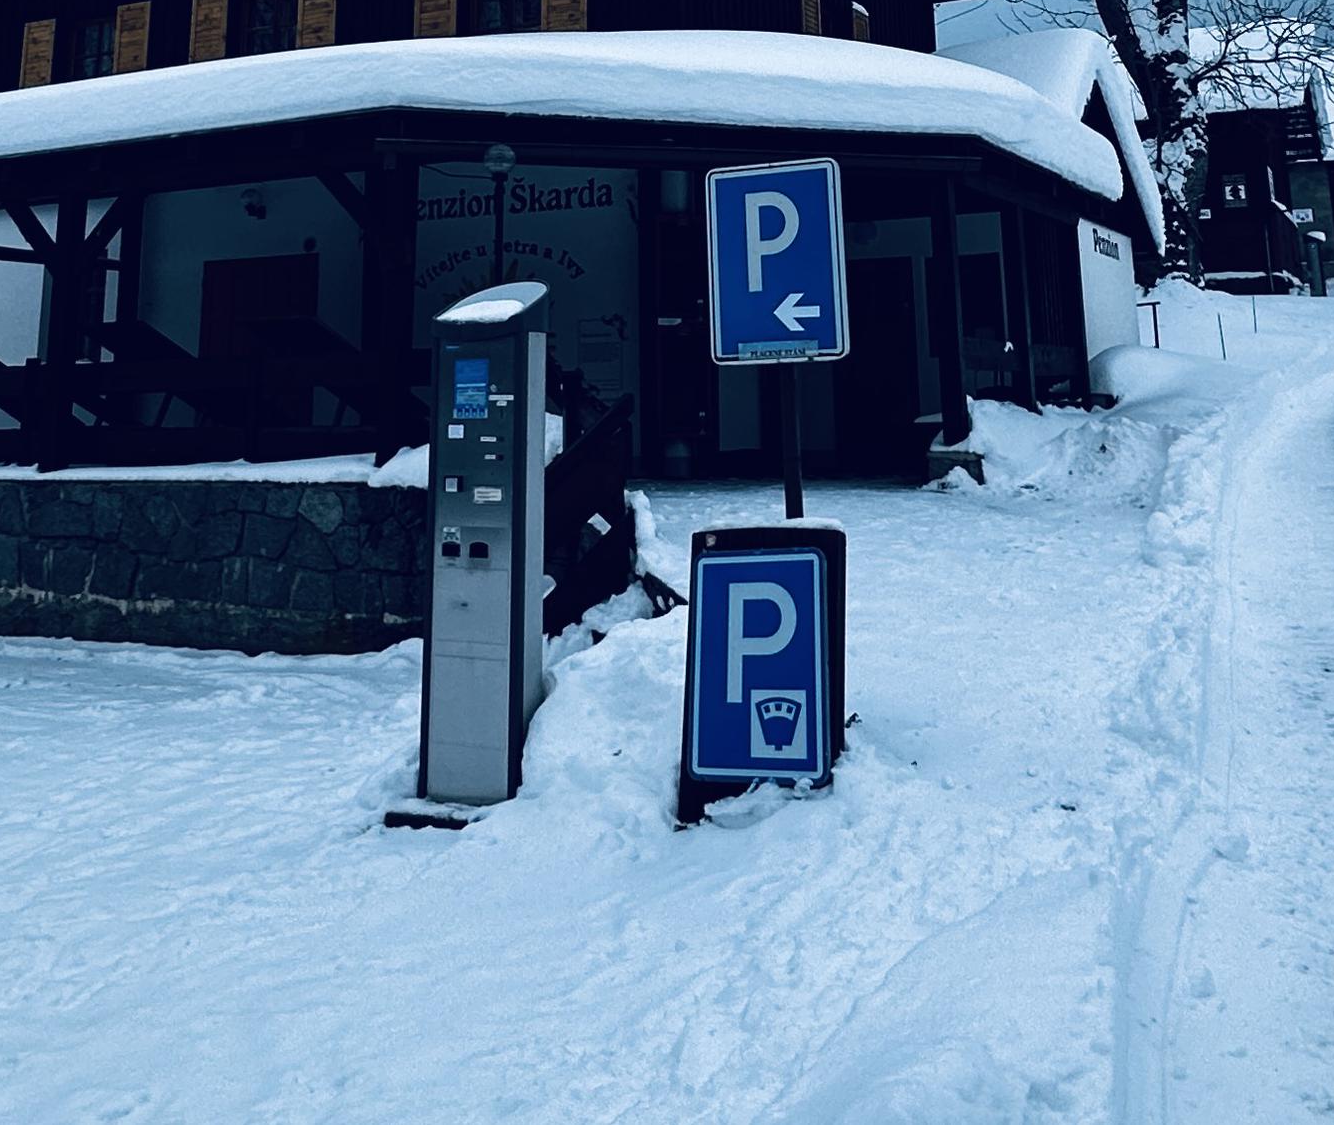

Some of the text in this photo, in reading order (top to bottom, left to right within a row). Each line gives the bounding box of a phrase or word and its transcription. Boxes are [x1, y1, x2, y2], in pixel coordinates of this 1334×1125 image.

[415, 177, 614, 221] enzion Škarda
[475, 245, 487, 257] u
[493, 239, 539, 256] etra
[543, 248, 553, 260] a
[557, 249, 586, 280] Ivy
[745, 191, 800, 292] P
[727, 582, 797, 703] P
